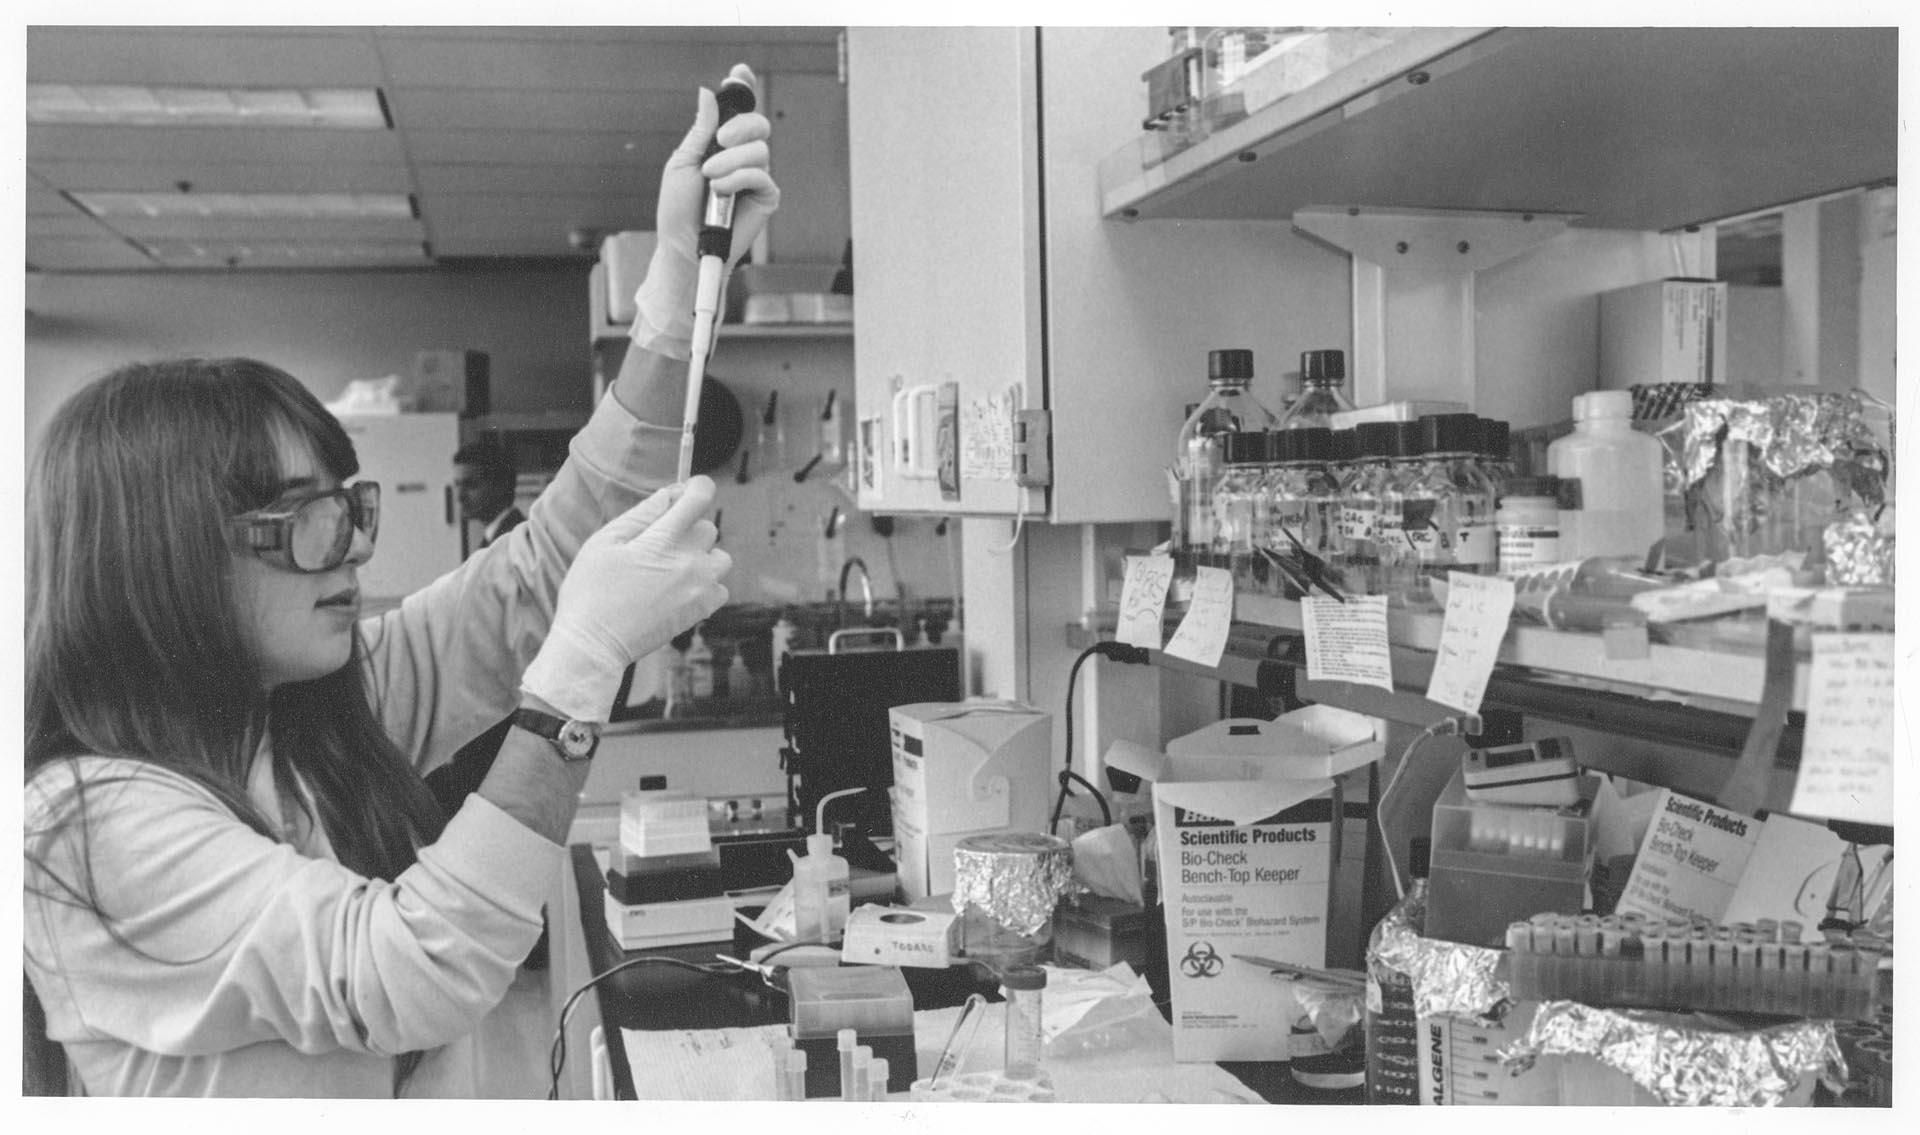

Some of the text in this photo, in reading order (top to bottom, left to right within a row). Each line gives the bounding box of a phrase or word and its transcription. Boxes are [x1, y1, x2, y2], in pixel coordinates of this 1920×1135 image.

[1703, 808, 1748, 837] Products
[1180, 826, 1317, 846] Scientific Products
[1181, 850, 1248, 866] Bio-Check
[1181, 865, 1300, 885] Bench-Top Keeper
[1430, 1023, 1444, 1106] ALGENE
